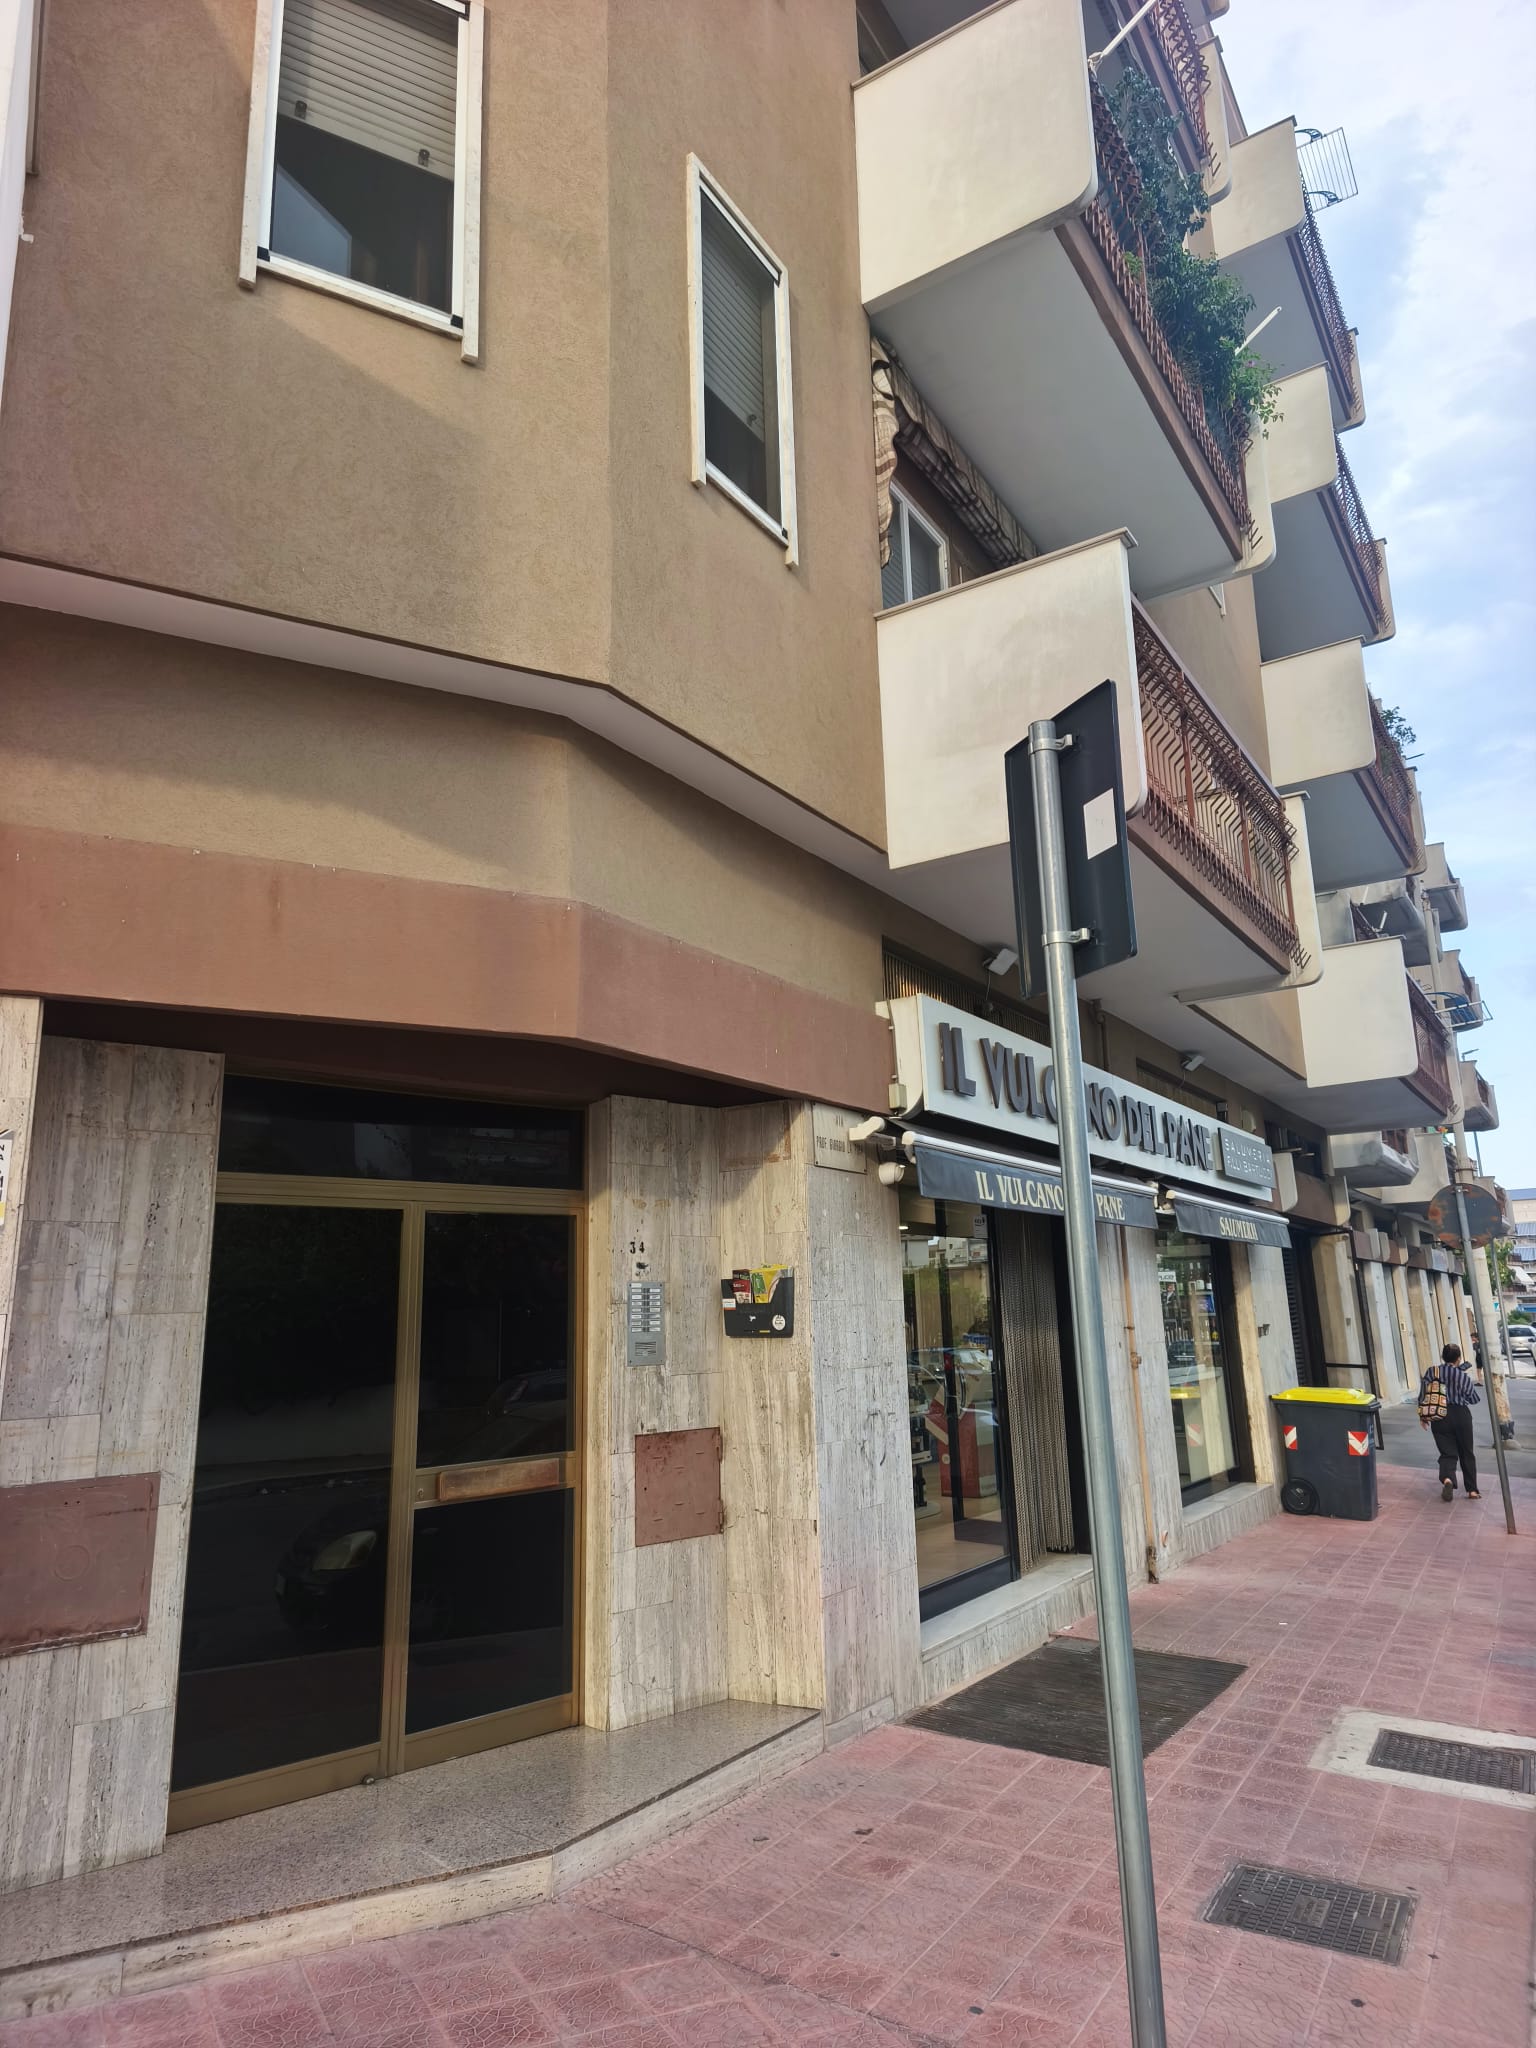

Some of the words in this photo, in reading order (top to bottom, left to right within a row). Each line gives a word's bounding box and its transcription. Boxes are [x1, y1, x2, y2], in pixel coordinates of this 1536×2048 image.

[939, 1022, 976, 1097] IL
[979, 1038, 1122, 1141] VULCNO
[1121, 1095, 1164, 1155] DEL
[1162, 1111, 1213, 1171] PANE
[975, 1170, 994, 1201] IL
[996, 1174, 1065, 1211] VULCANO
[1095, 1193, 1126, 1221] PANE
[630, 1241, 645, 1254] 34
